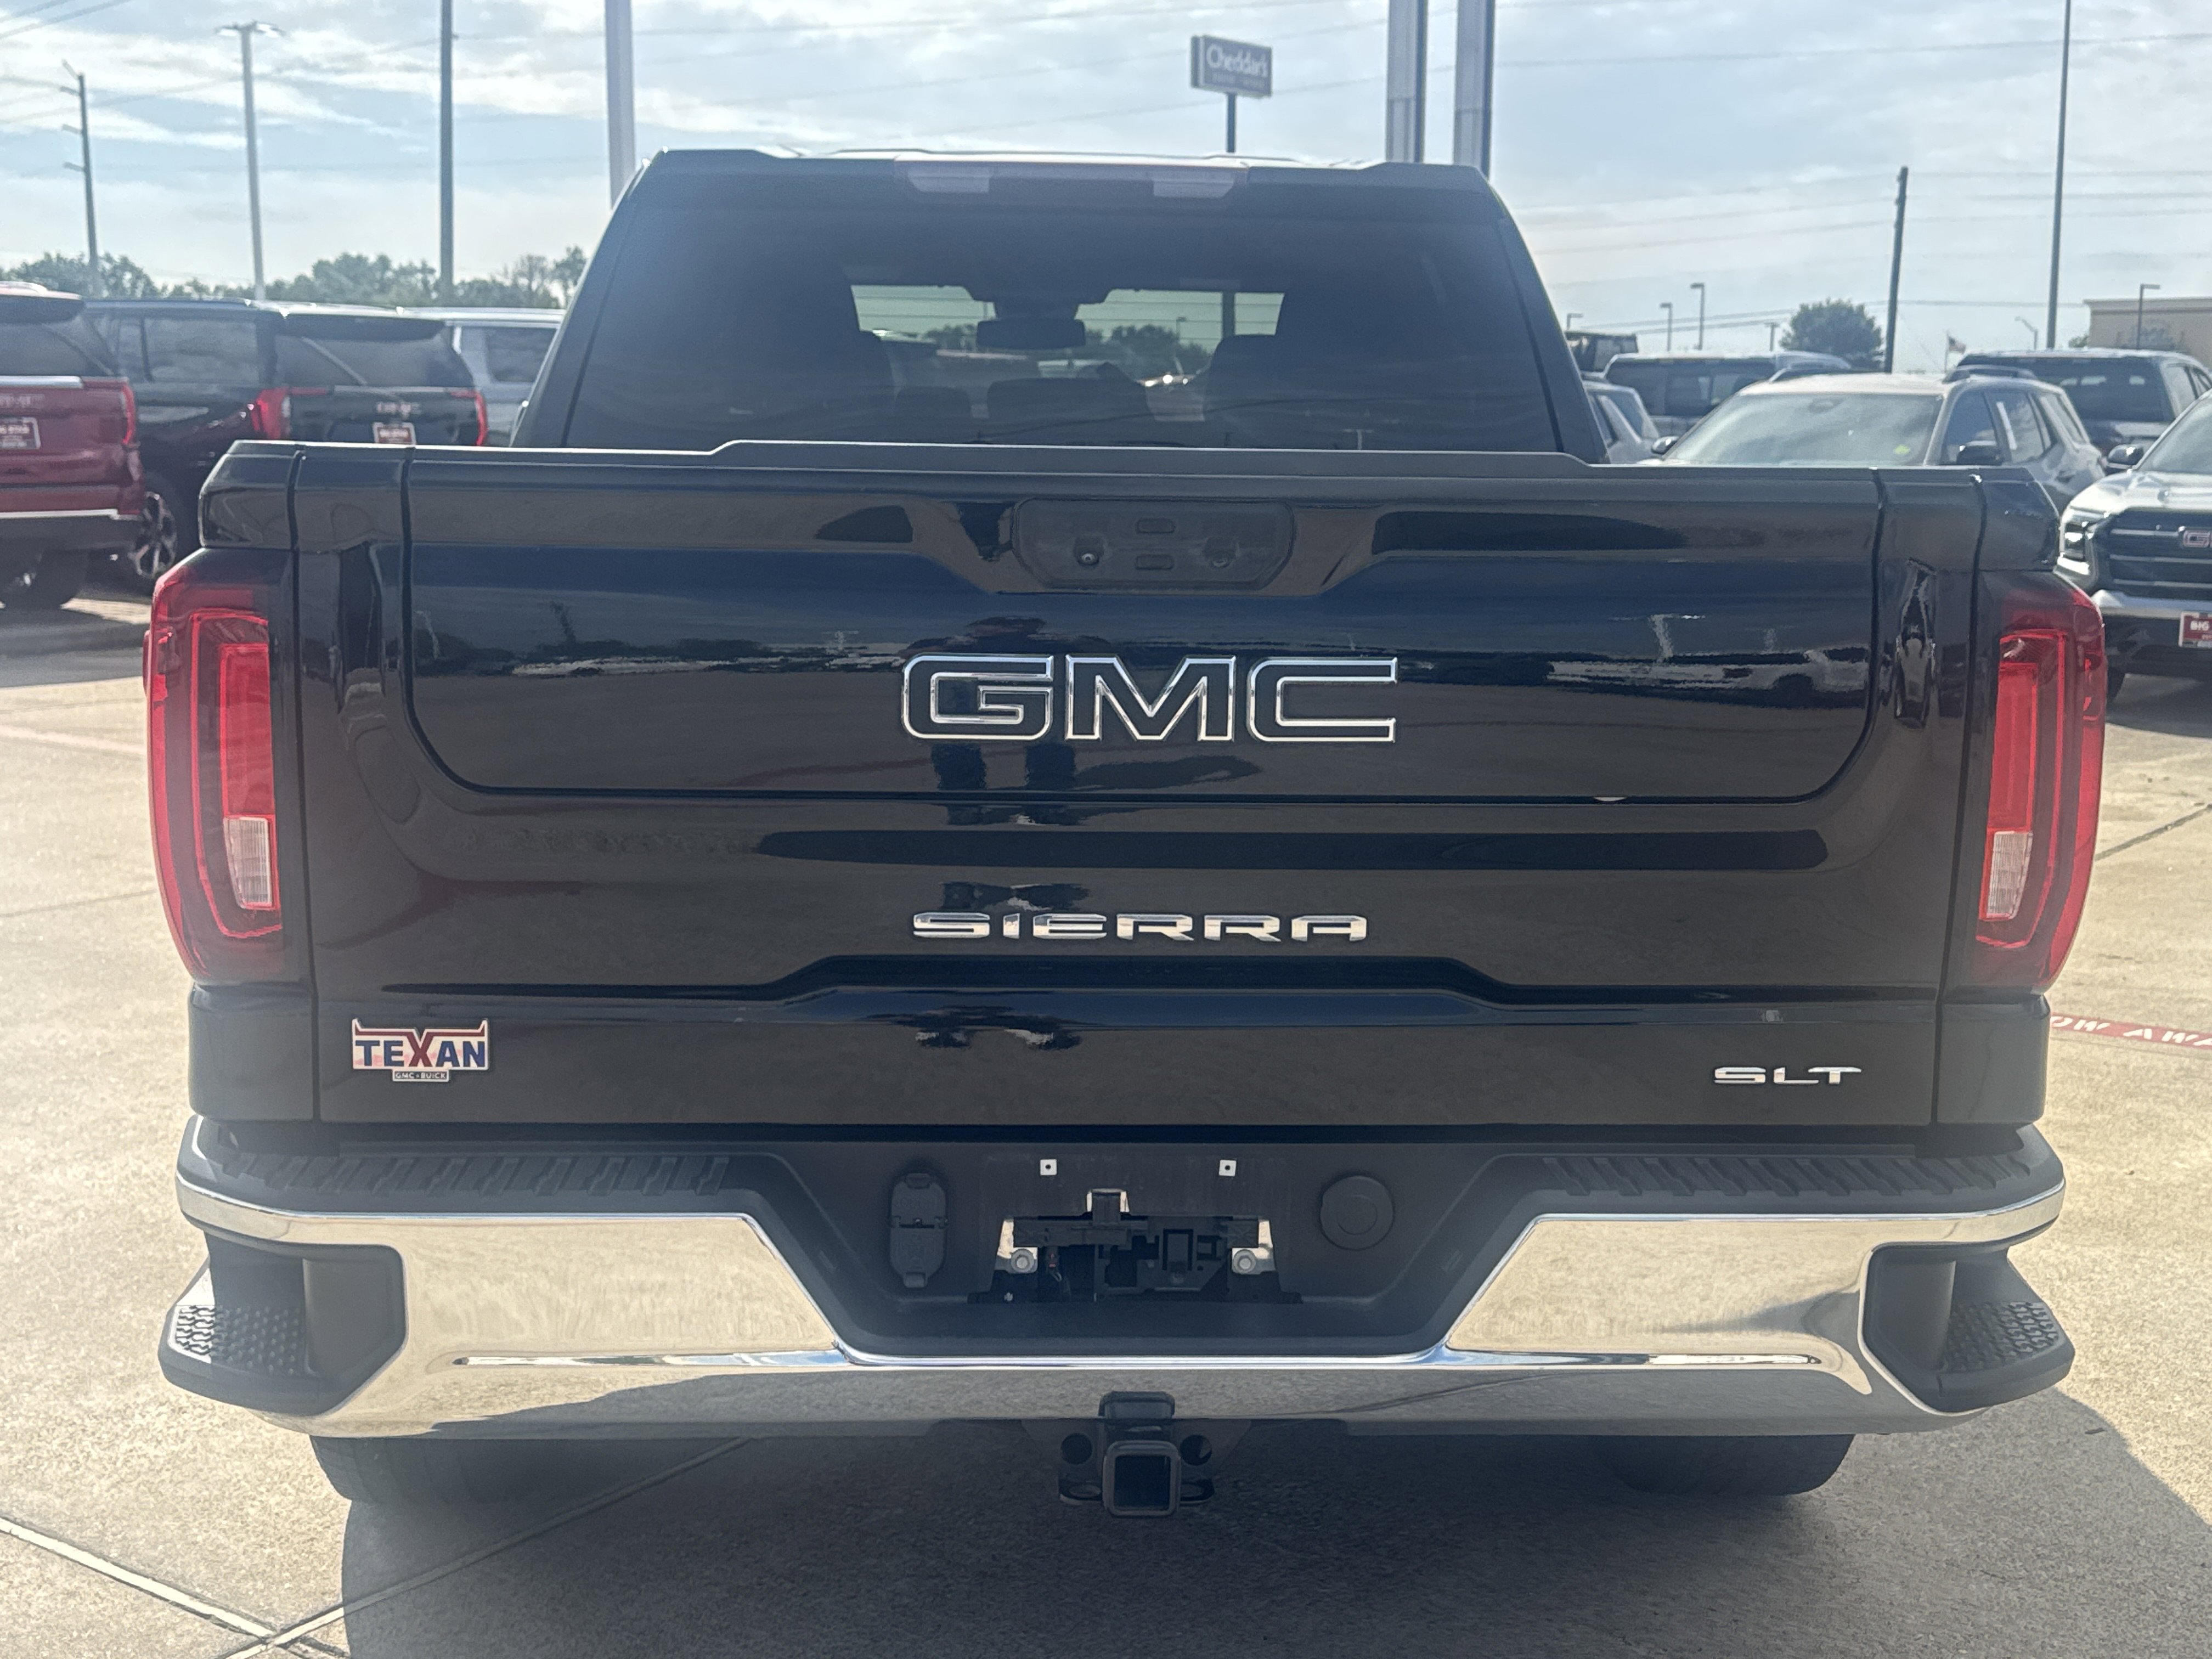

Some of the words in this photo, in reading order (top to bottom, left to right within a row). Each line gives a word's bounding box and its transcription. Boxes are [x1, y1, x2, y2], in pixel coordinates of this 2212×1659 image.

[902, 655, 1399, 743] GMC
[913, 912, 1368, 942] SIERRA
[354, 1030, 486, 1068] TEXAN
[1714, 1066, 1862, 1085] SLT
